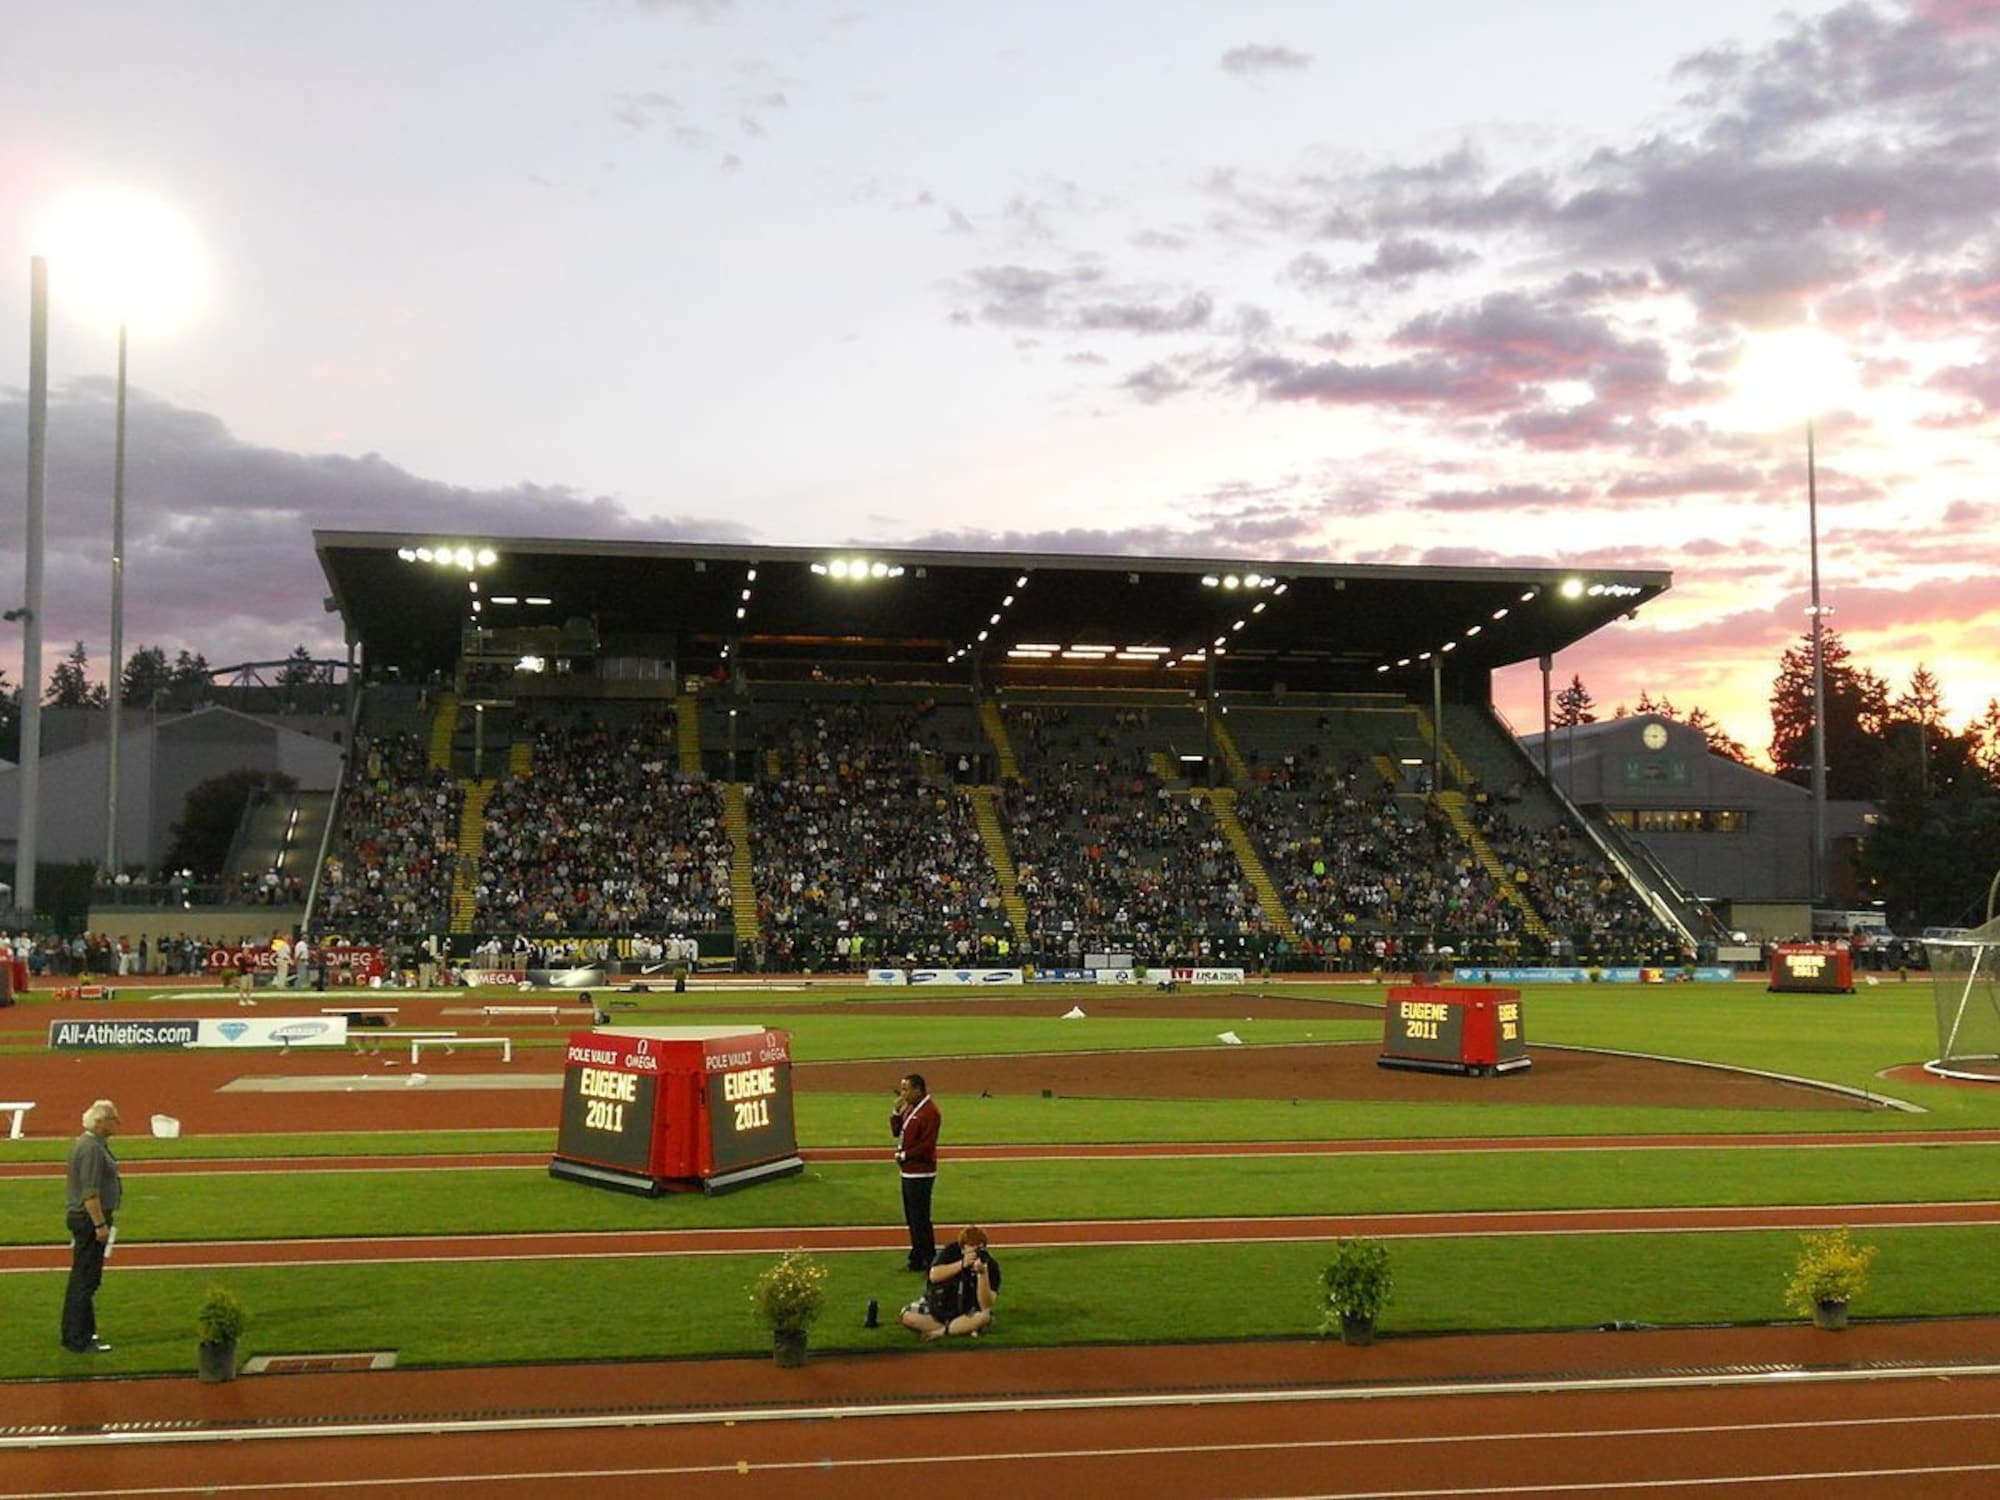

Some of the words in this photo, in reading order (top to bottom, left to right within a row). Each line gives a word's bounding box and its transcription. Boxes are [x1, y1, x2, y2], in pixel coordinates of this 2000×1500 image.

[1400, 1001, 1448, 1021] EUGENE
[57, 1023, 191, 1045] All-Athletics.com
[1406, 1021, 1438, 1039] 2011
[568, 1047, 591, 1063] POLE
[591, 1050, 618, 1065] VAULT
[625, 1054, 658, 1070] OMEGA
[706, 1054, 728, 1070] POLE
[728, 1051, 752, 1067] VAULT
[760, 1047, 787, 1063] OMEGA
[580, 1067, 638, 1102] EUGENE
[724, 1066, 776, 1101] EUGENE
[586, 1100, 623, 1132] 2011
[734, 1099, 770, 1131] 2011
